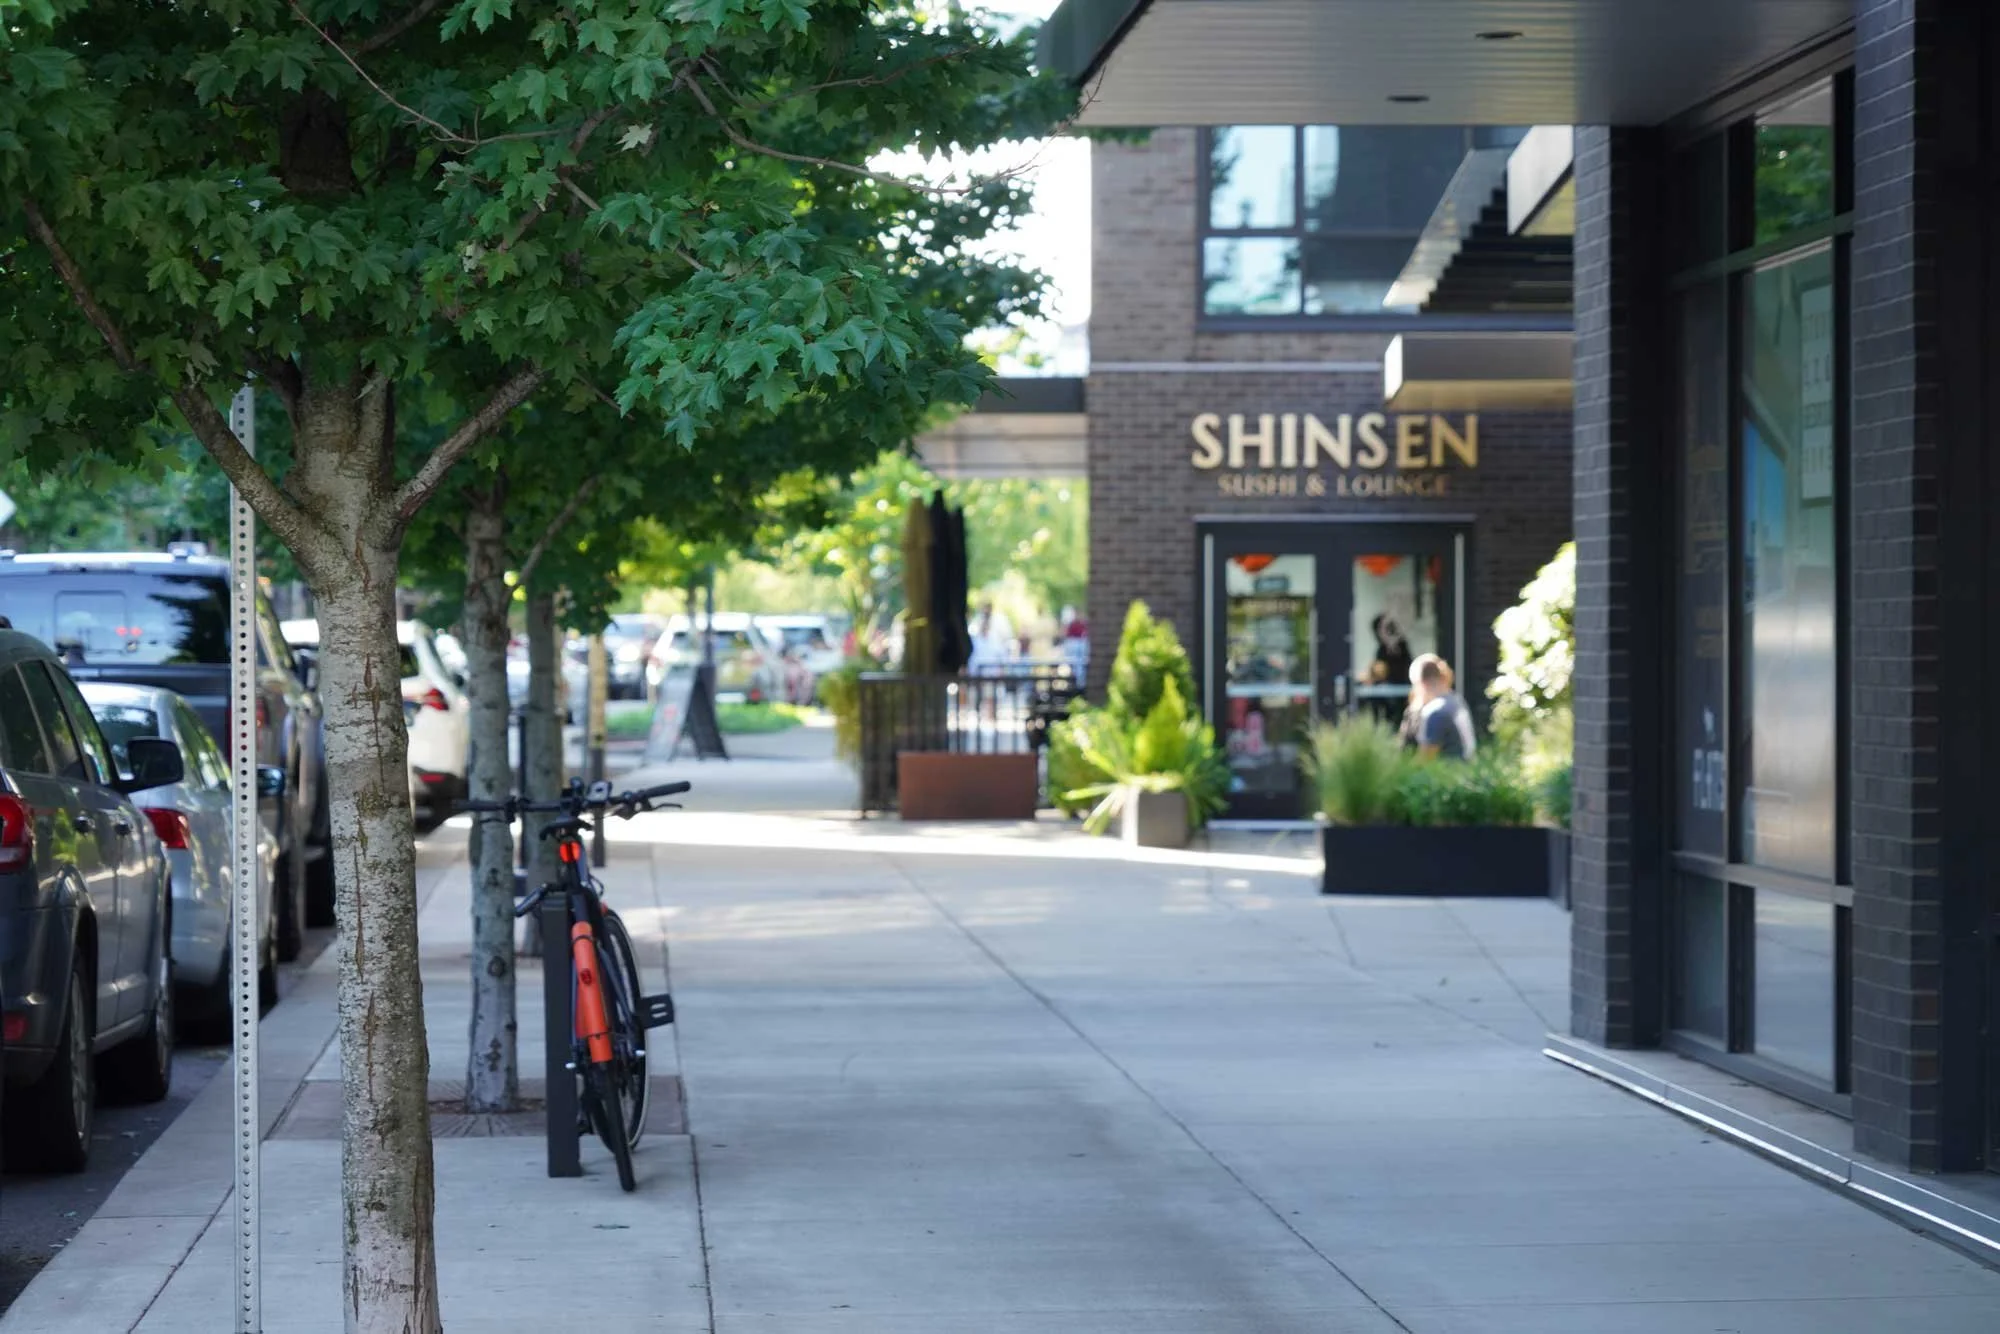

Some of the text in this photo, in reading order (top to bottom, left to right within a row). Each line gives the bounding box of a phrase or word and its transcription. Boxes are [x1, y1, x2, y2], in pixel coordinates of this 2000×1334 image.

[1191, 412, 1479, 469] SHINSEN
[1217, 473, 1450, 498] SUSHI & LOUNGE
